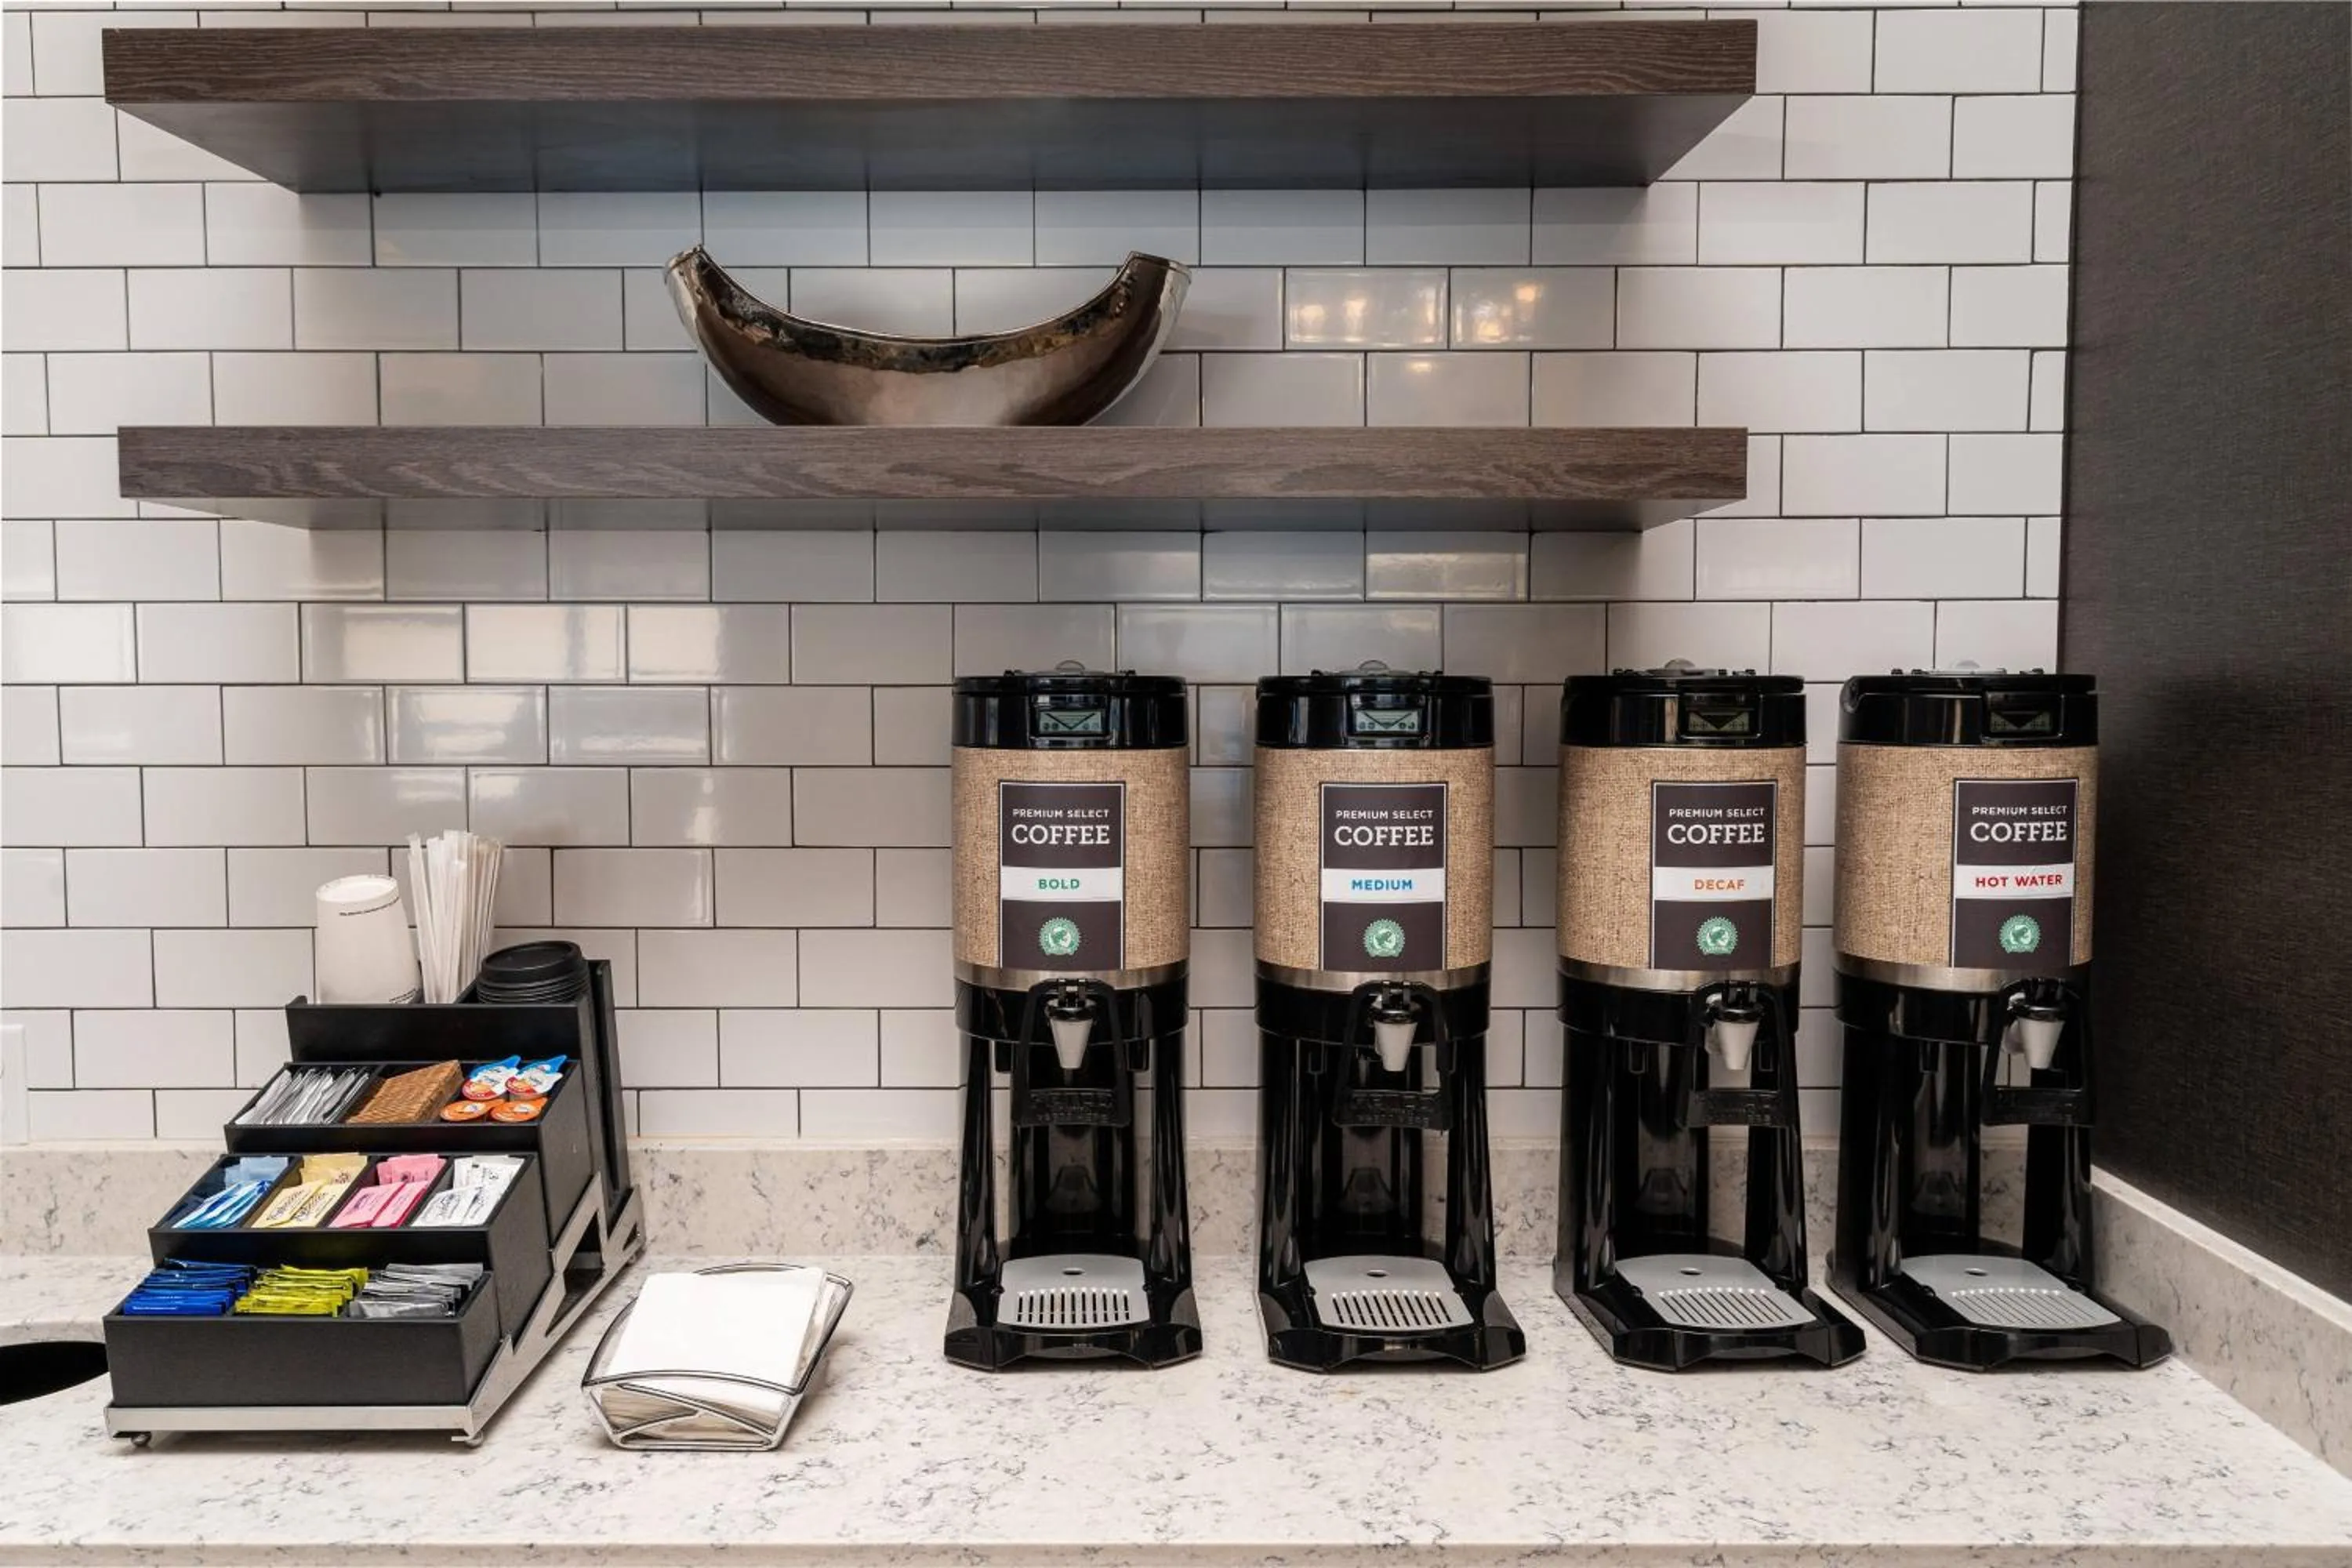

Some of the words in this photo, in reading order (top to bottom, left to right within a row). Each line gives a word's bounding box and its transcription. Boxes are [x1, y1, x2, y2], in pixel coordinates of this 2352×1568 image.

[1012, 808, 1064, 818] PREMIUM
[1066, 808, 1109, 818] SELECT
[1335, 809, 1389, 820] PREMIUM
[1392, 810, 1434, 819] SELECT
[1668, 808, 1723, 818] PREMIUM
[1726, 808, 1765, 818] SELECT
[1972, 806, 2027, 816] PREMIUM
[2031, 805, 2067, 815] SELECT
[1011, 823, 1111, 846] COFFEE
[1334, 825, 1434, 847] COFFEE
[1667, 822, 1765, 844] COFFEE
[1969, 821, 2067, 843] COFFEE
[1038, 878, 1080, 890] BOLD
[1352, 879, 1413, 891] MEDIUM
[1694, 879, 1744, 891] DECAF
[1975, 876, 2009, 888] HOT
[2014, 873, 2063, 887] WATER
